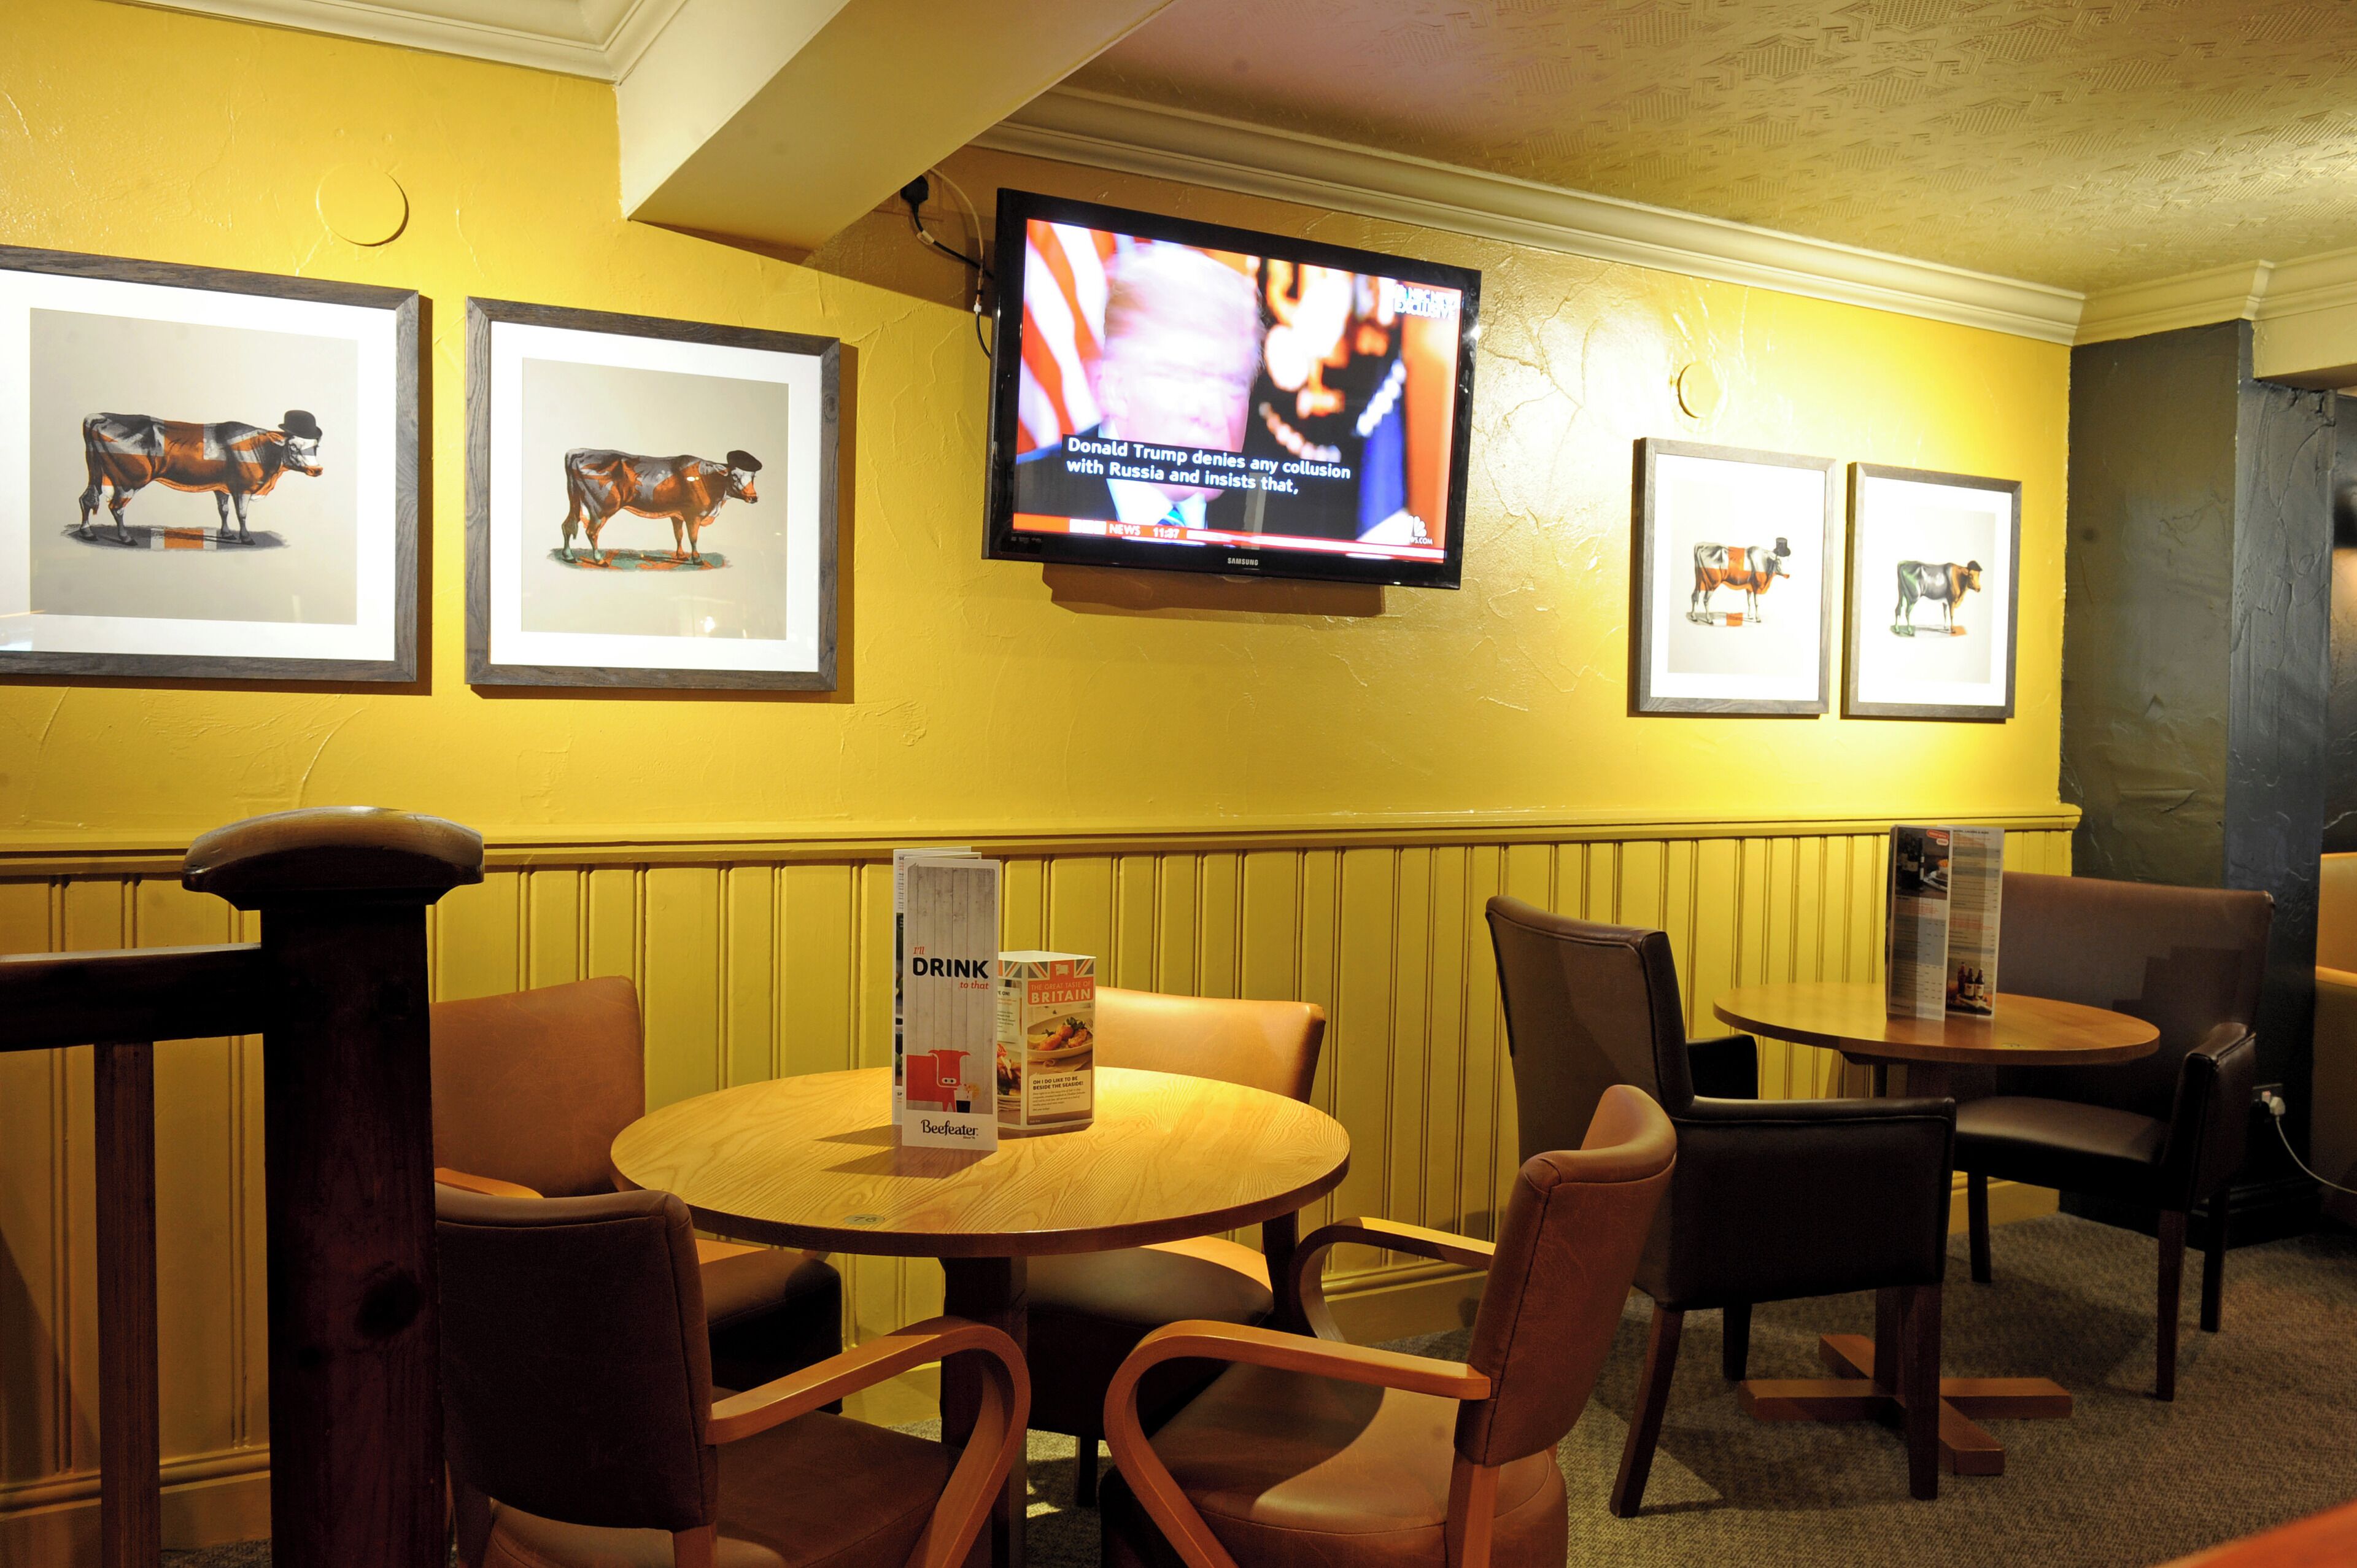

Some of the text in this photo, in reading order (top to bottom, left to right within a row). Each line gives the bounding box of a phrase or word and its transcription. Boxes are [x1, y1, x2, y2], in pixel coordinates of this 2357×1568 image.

[1068, 437, 1350, 479] Donald Trump denies any collusion
[1066, 458, 1299, 495] with Russia and insists that,
[1109, 523, 1141, 536] NEWS
[1228, 557, 1258, 566] SAMSUNG
[913, 946, 924, 955] I'll
[913, 957, 989, 979] DRINK
[971, 980, 989, 989] that
[1031, 989, 1091, 1003] BRITAIN
[921, 1119, 978, 1136] Beefeater
